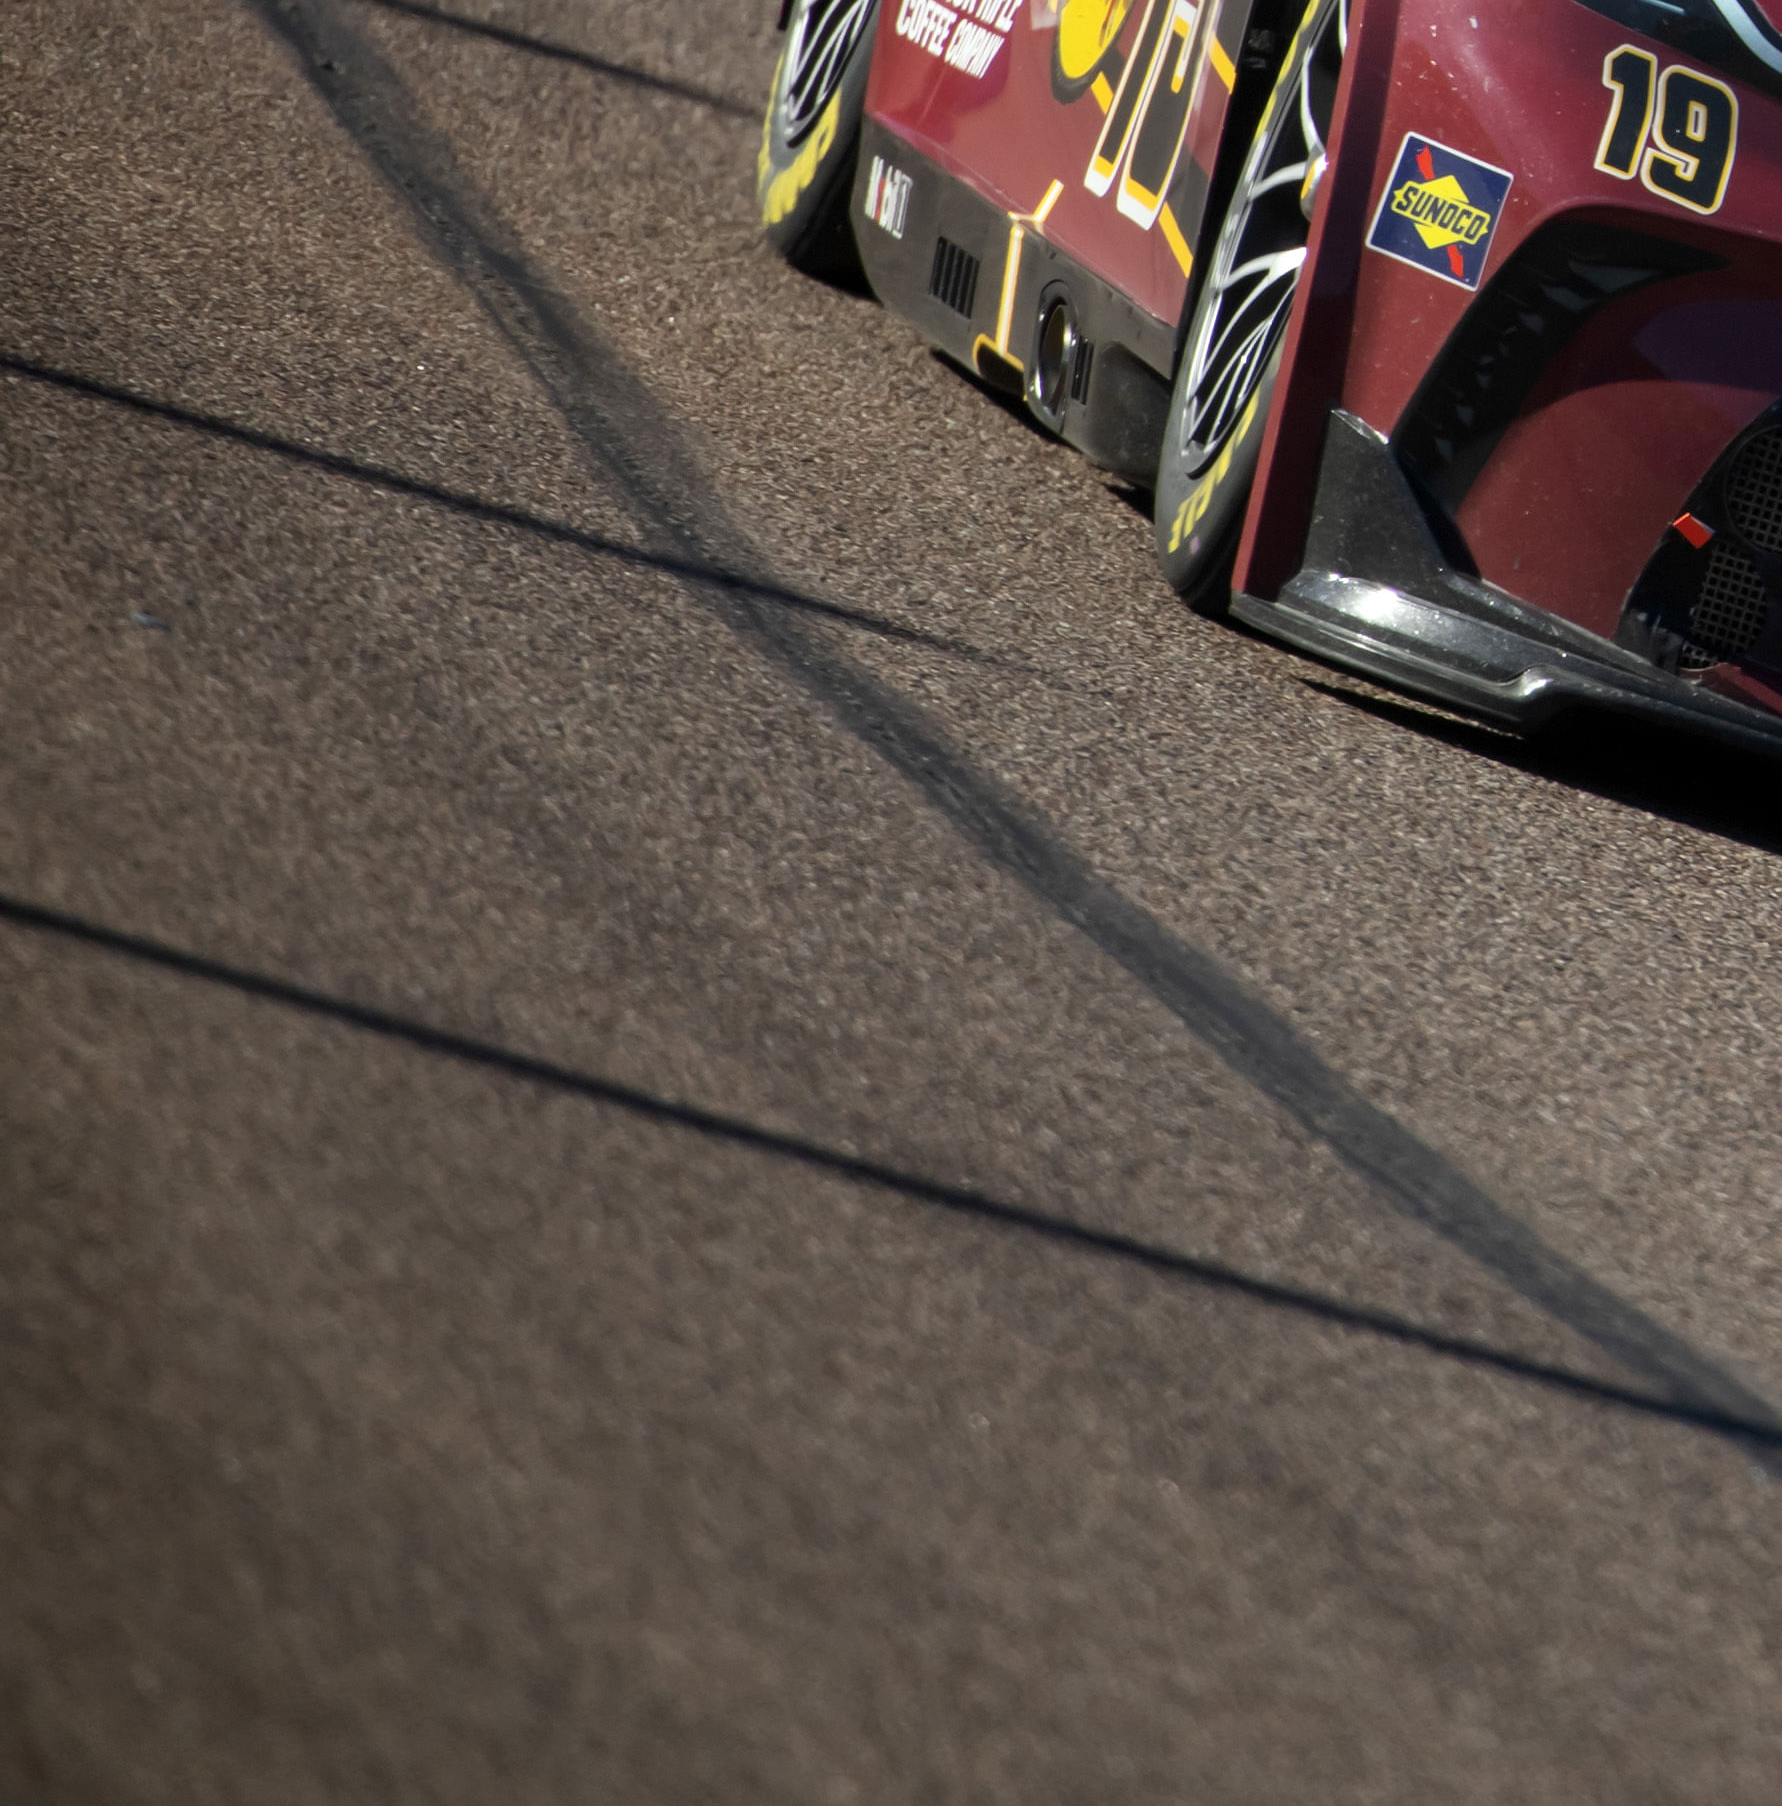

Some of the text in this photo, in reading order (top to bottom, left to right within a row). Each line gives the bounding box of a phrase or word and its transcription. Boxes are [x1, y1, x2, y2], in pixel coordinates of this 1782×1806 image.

[944, 17, 1005, 79] COMPANY
[1593, 44, 1739, 215] 19
[1395, 185, 1487, 240] SUNOCO
